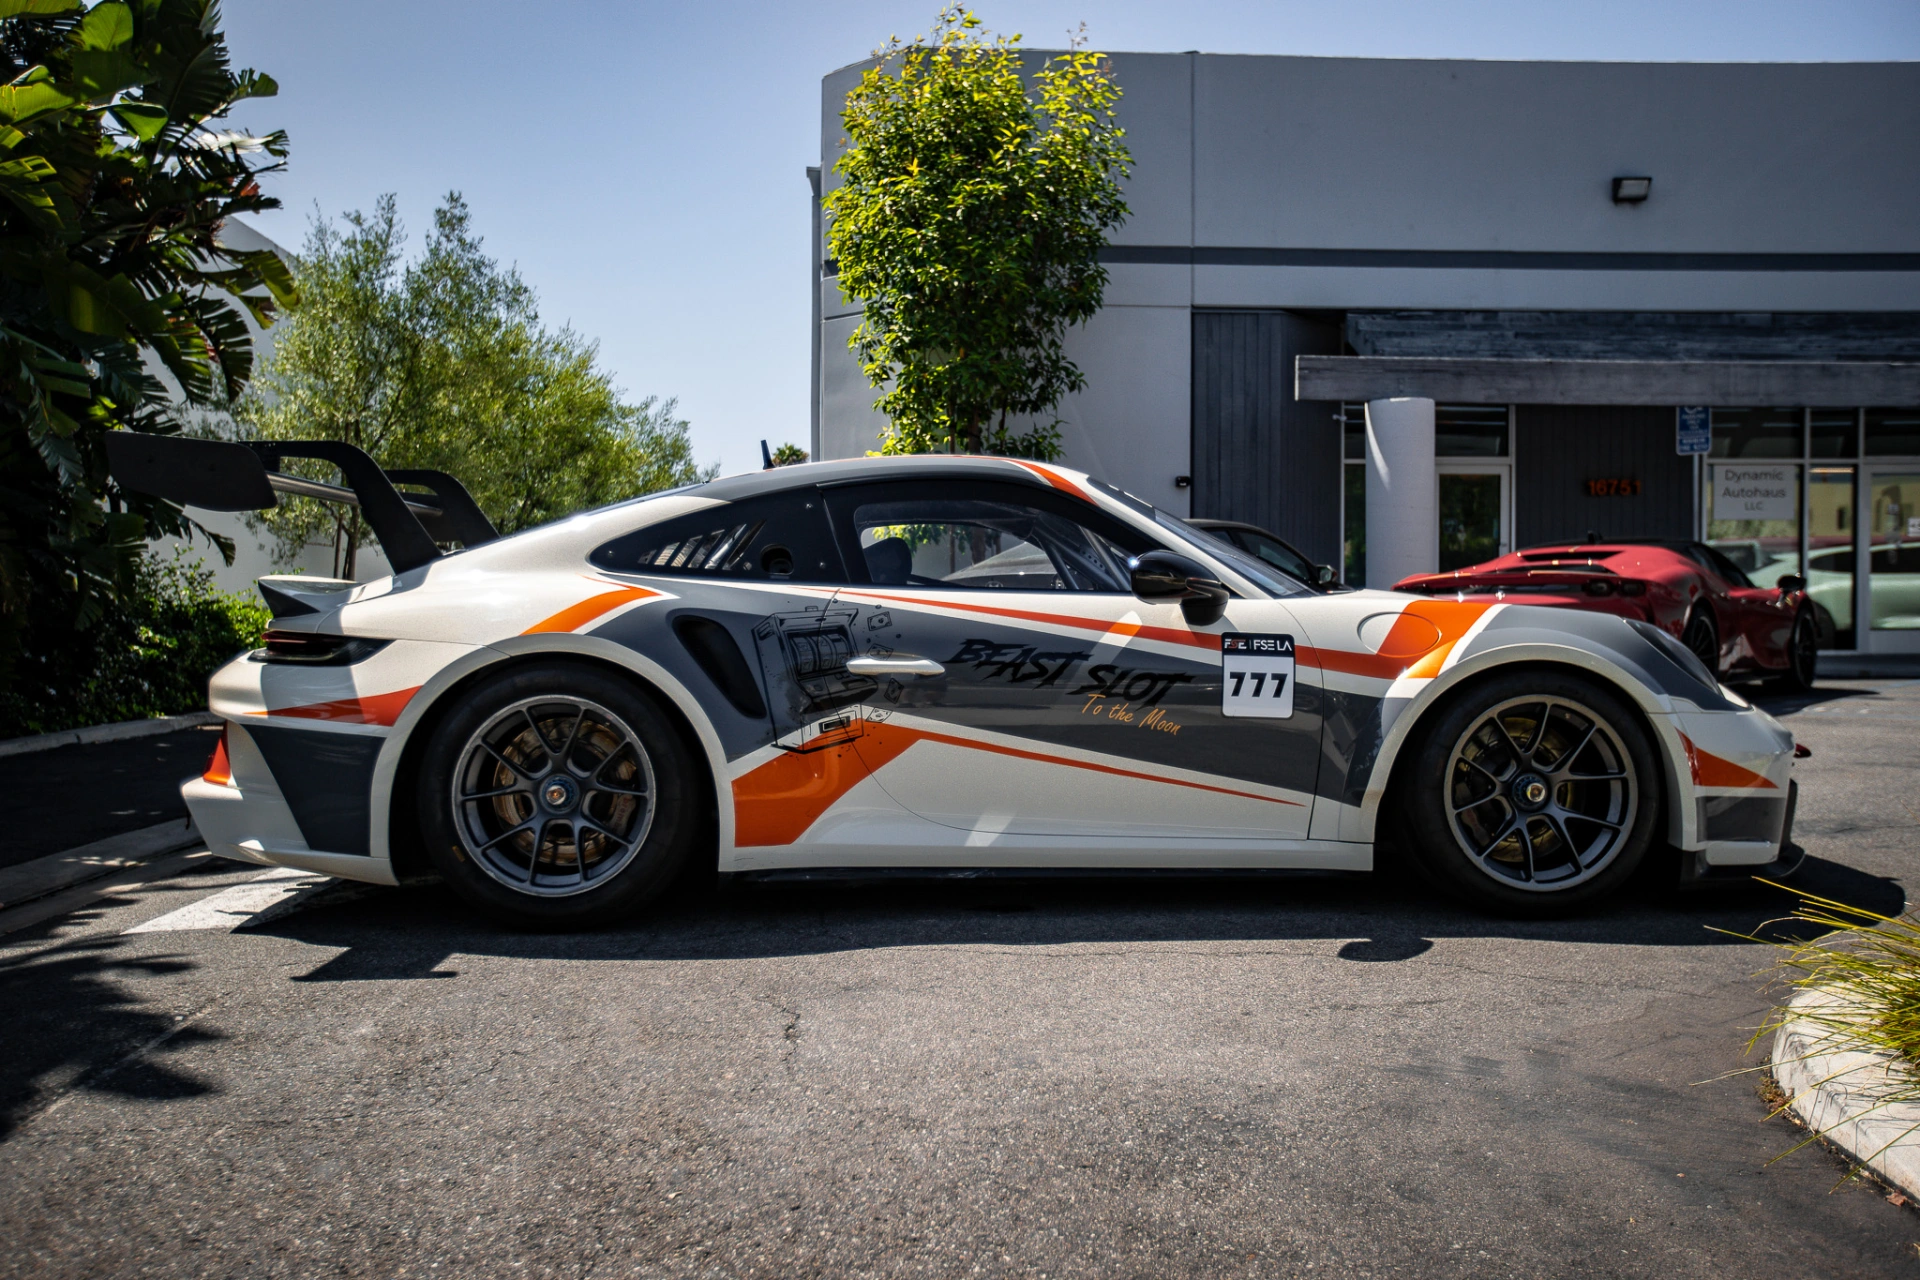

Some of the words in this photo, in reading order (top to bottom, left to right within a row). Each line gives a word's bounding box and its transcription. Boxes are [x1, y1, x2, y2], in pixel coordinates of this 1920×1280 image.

[1724, 468, 1784, 483] Dynamic
[1588, 478, 1641, 496] 16751
[1722, 487, 1787, 499] Autohaus
[1744, 501, 1764, 511] LLC
[941, 638, 1094, 690] BEAST
[1066, 663, 1197, 711] SLOT
[1229, 671, 1288, 698] 777
[1081, 693, 1106, 715] To
[1108, 702, 1134, 723] the
[1138, 707, 1181, 736] Moon
